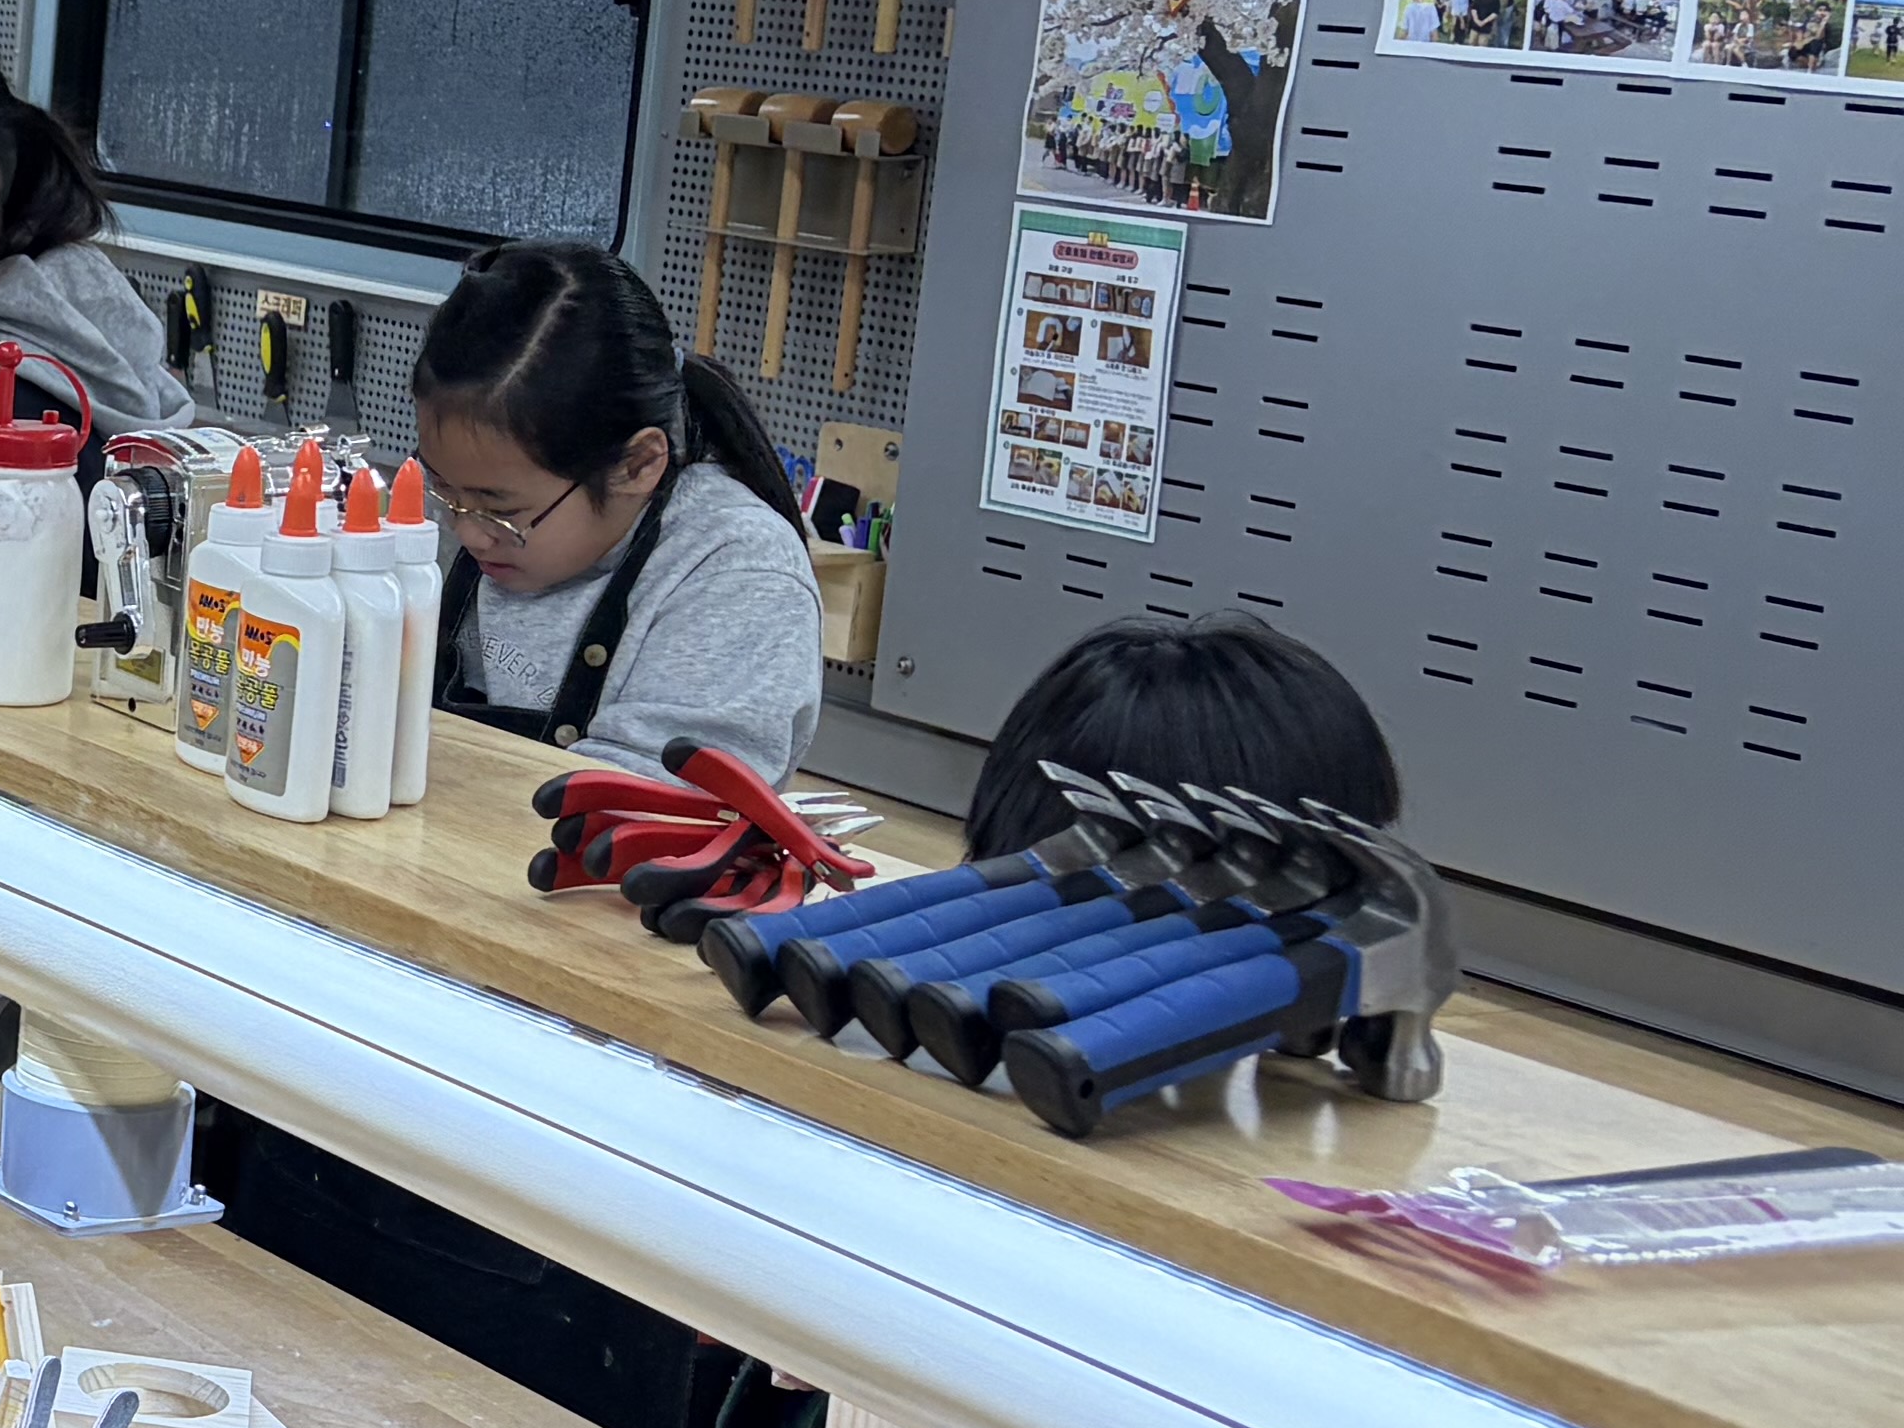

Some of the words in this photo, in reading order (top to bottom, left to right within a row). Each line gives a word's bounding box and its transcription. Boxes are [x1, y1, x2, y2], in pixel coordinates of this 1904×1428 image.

[195, 616, 225, 644] 만능
[188, 640, 232, 675] 목공풀
[241, 648, 271, 678] 만능
